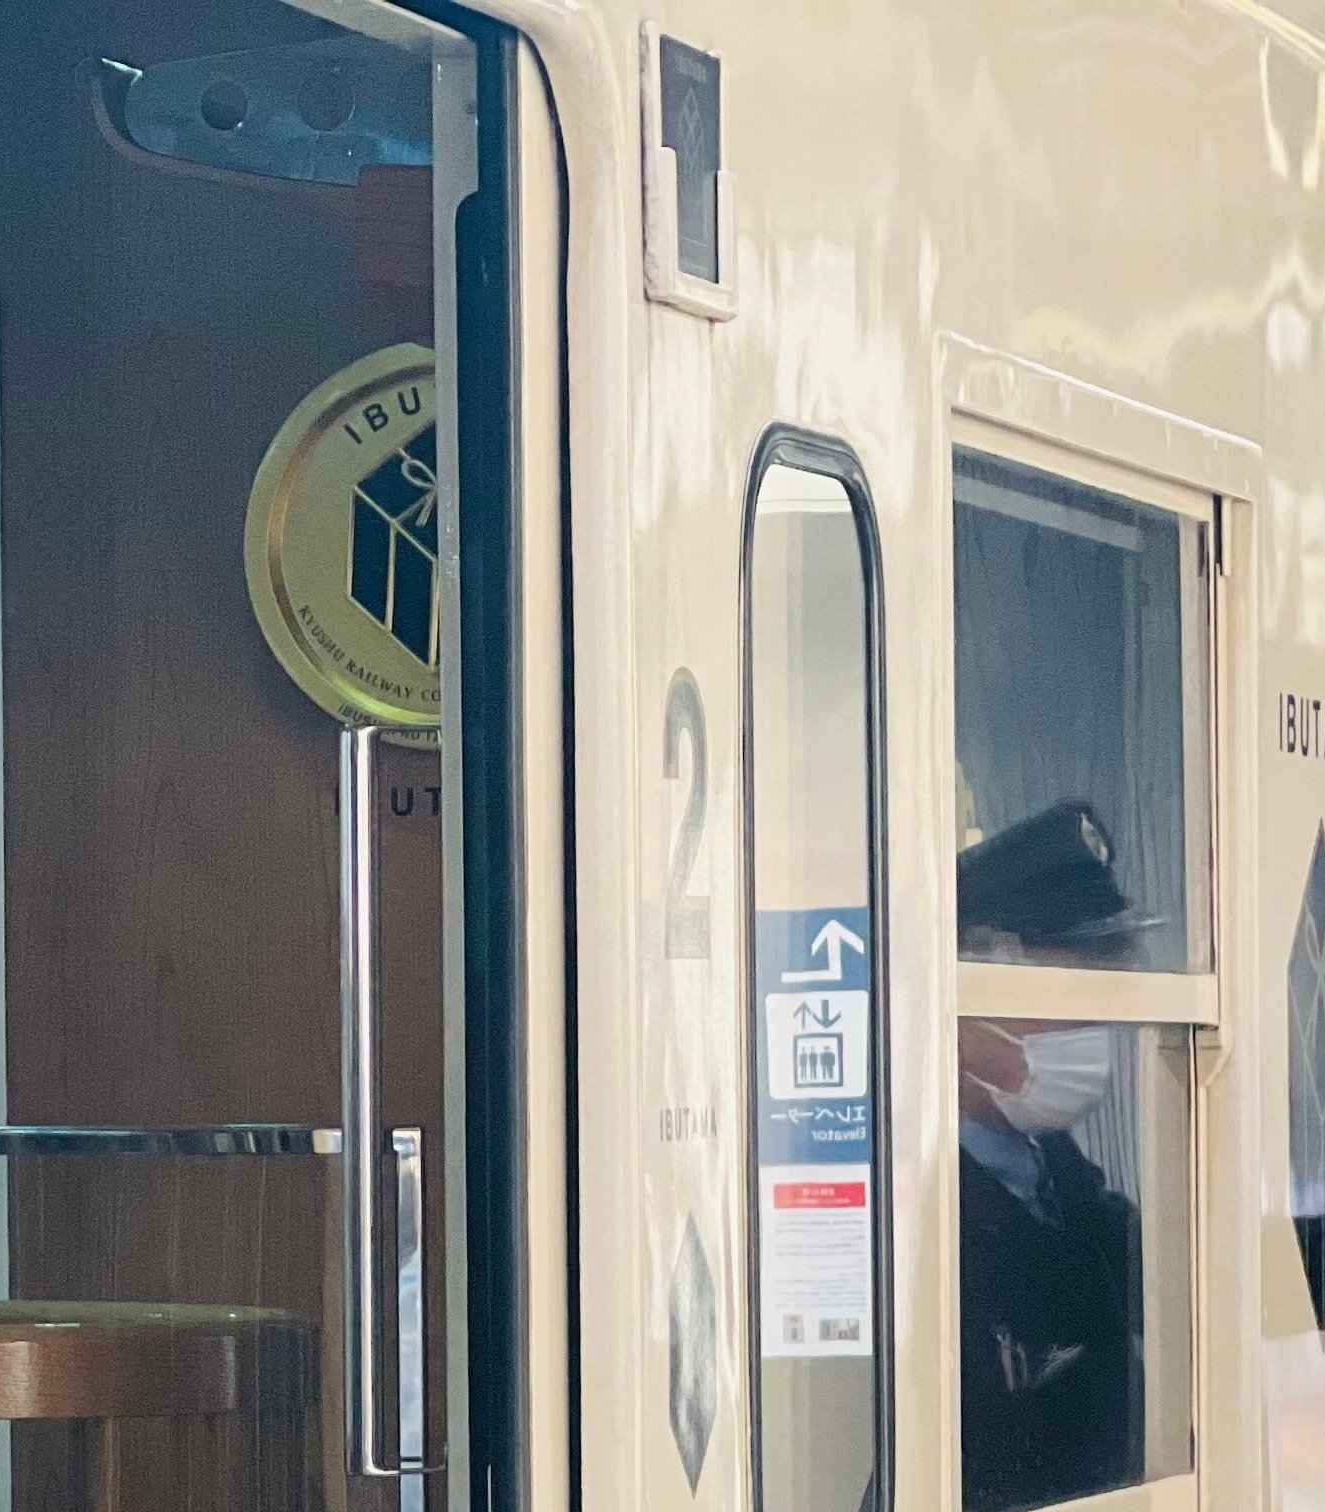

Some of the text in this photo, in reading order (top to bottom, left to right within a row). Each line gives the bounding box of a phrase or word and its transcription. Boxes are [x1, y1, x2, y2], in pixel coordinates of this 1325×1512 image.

[343, 385, 421, 444] IBU
[298, 604, 345, 662] KYUSHU
[345, 658, 414, 701] RAILWAY
[662, 666, 711, 960] 2
[659, 1105, 717, 1142] IBUTAMA
